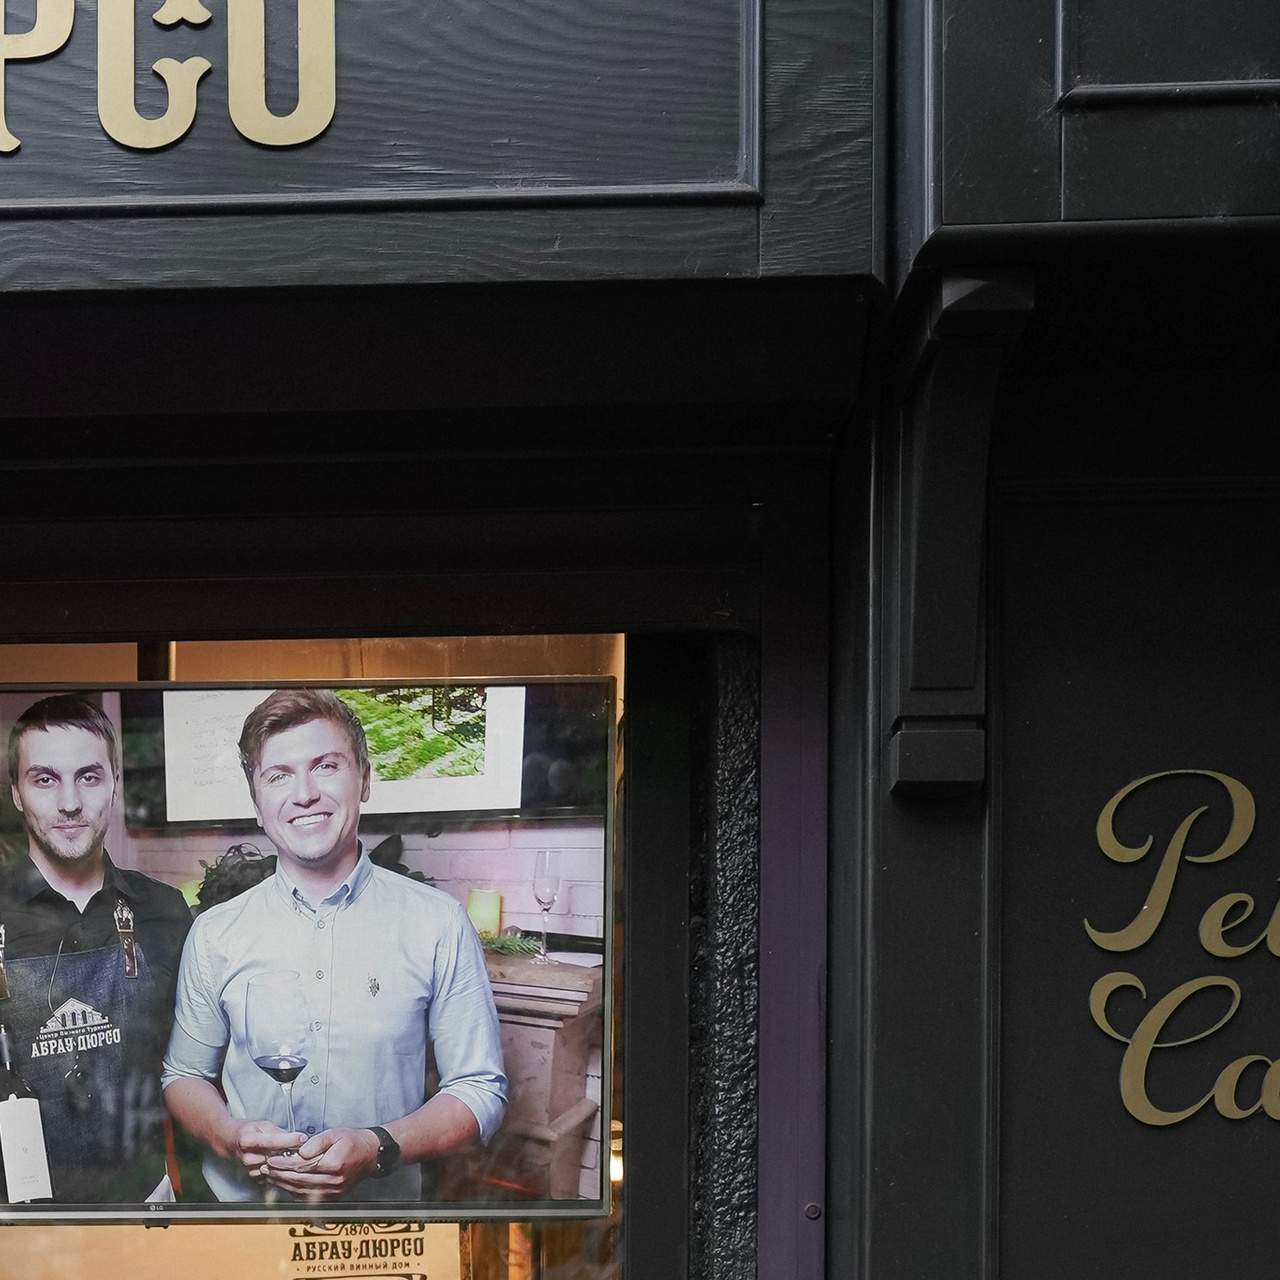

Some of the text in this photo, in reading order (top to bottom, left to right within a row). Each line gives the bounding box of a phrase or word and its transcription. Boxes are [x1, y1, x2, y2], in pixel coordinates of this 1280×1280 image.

[1083, 769, 1280, 957] Pe
[344, 1225, 369, 1235] 1870
[307, 1261, 410, 1272] РУССКИЙ ВИННЫЙ ДОМ
